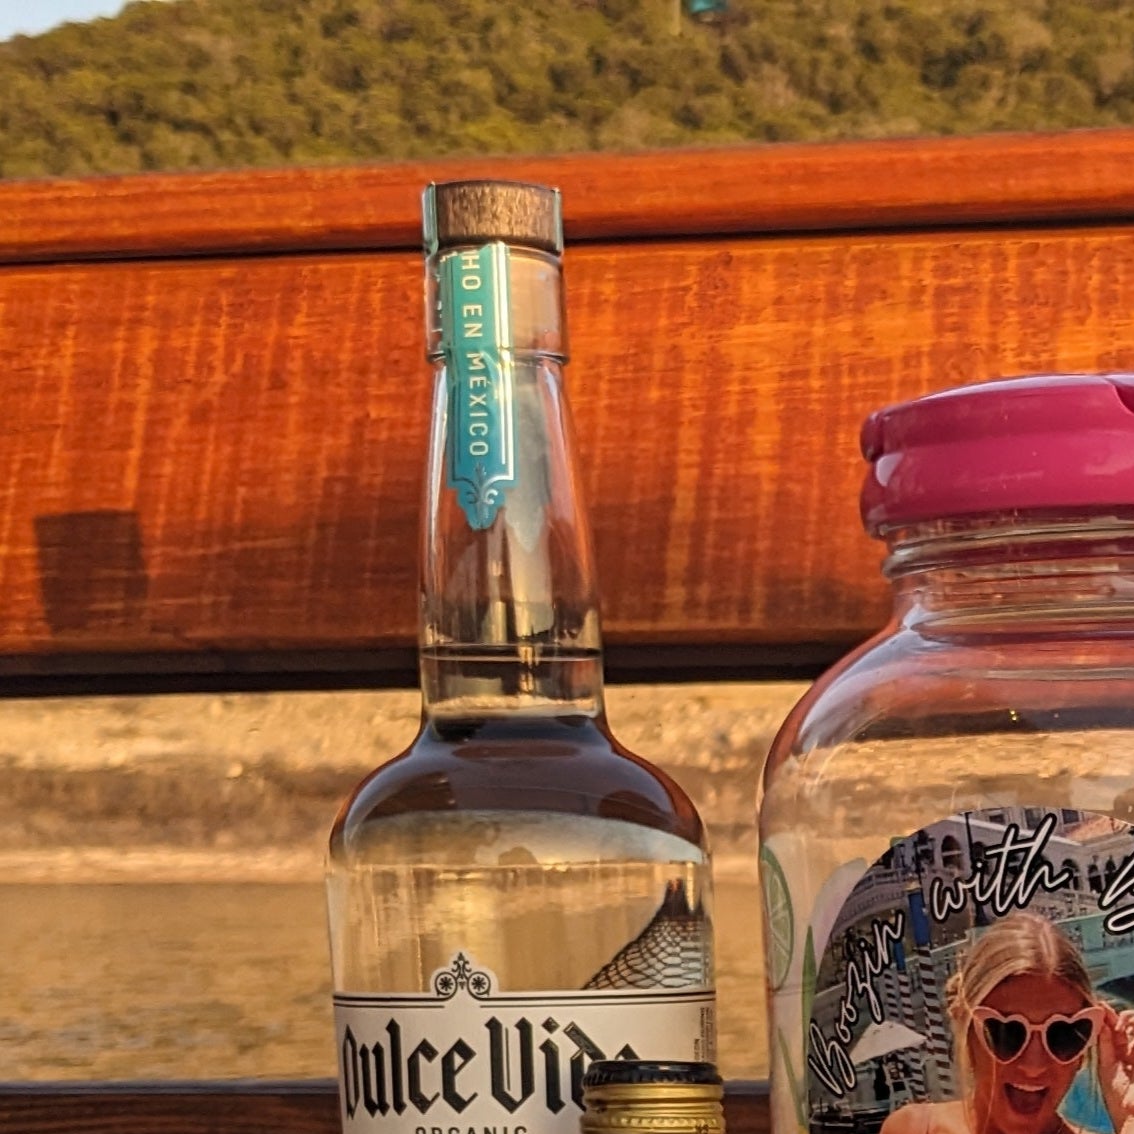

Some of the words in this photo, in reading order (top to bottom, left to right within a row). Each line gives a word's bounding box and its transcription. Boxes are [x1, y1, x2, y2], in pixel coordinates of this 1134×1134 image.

[463, 304, 483, 338] EN
[466, 352, 490, 457] MÉXICO
[809, 910, 906, 1098] Boozin
[930, 813, 1073, 921] with
[342, 1017, 478, 1120] Dulce
[484, 1016, 641, 1115] Vid
